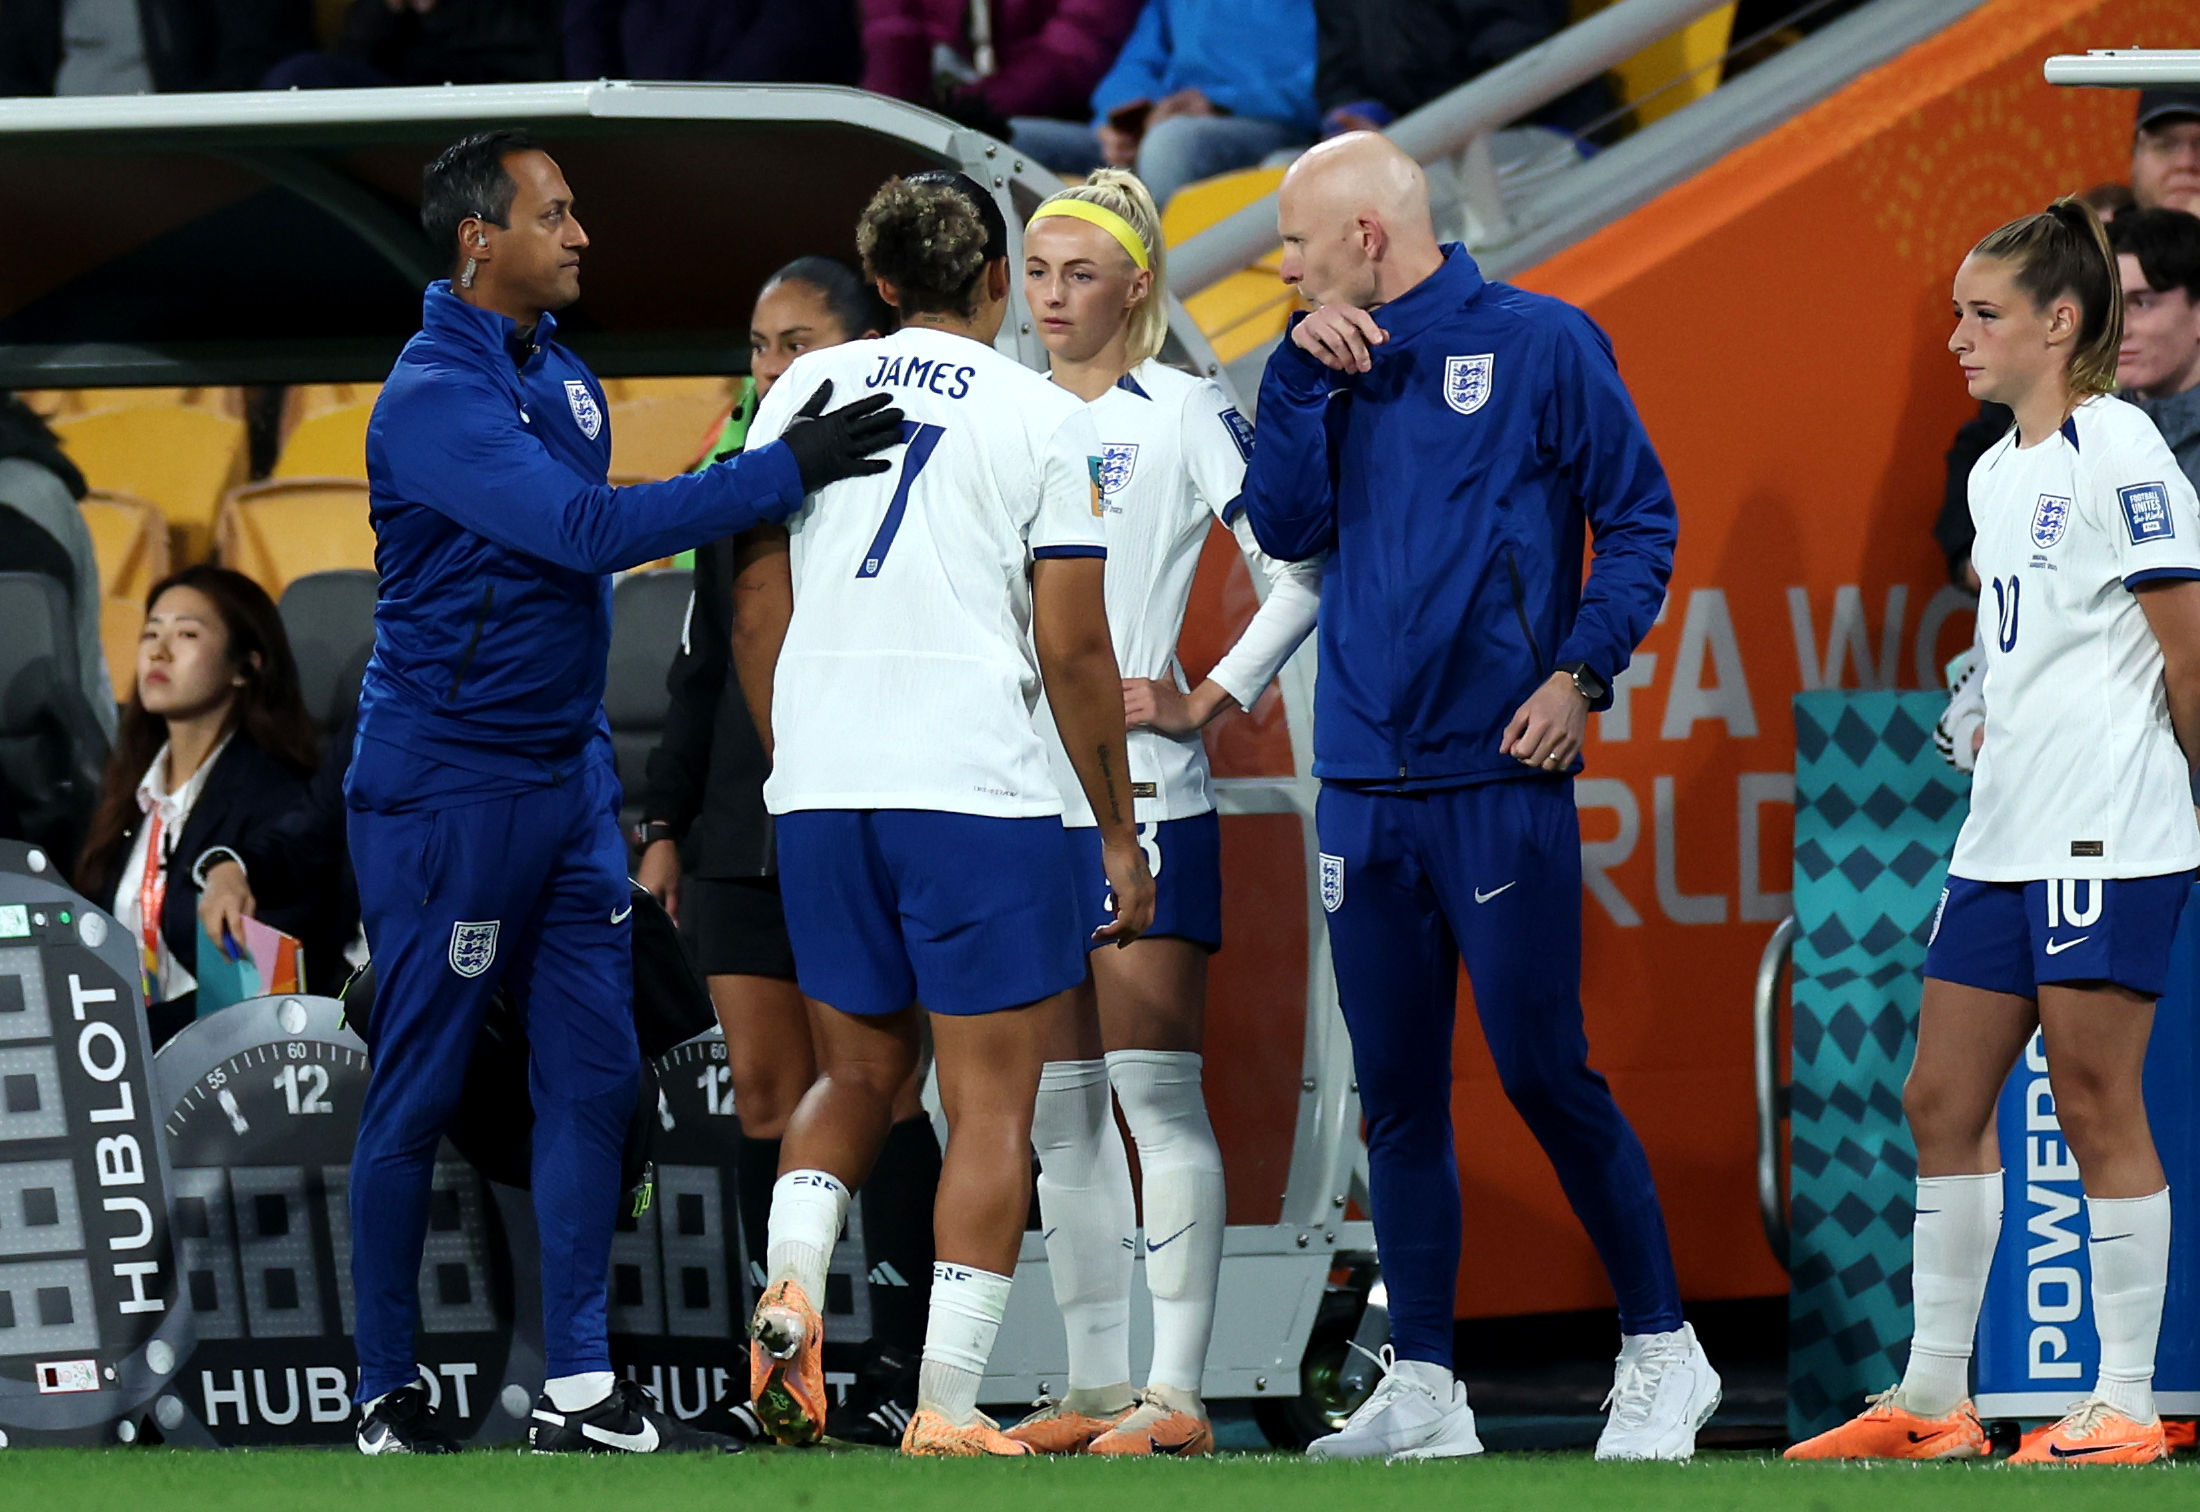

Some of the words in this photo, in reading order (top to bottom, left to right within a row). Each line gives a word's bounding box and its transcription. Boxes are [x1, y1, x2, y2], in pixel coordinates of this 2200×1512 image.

[866, 356, 976, 399] JAMES
[857, 419, 947, 579] 7
[2131, 499, 2161, 514] UNITES
[1992, 574, 2020, 653] 10
[1574, 772, 1794, 927] RLD
[2047, 879, 2102, 928] 10
[287, 1042, 307, 1059] 60
[206, 1067, 227, 1090] 55
[273, 1064, 333, 1114] 12
[68, 974, 165, 1314] HUBLOT
[202, 1363, 477, 1426] HUBT
